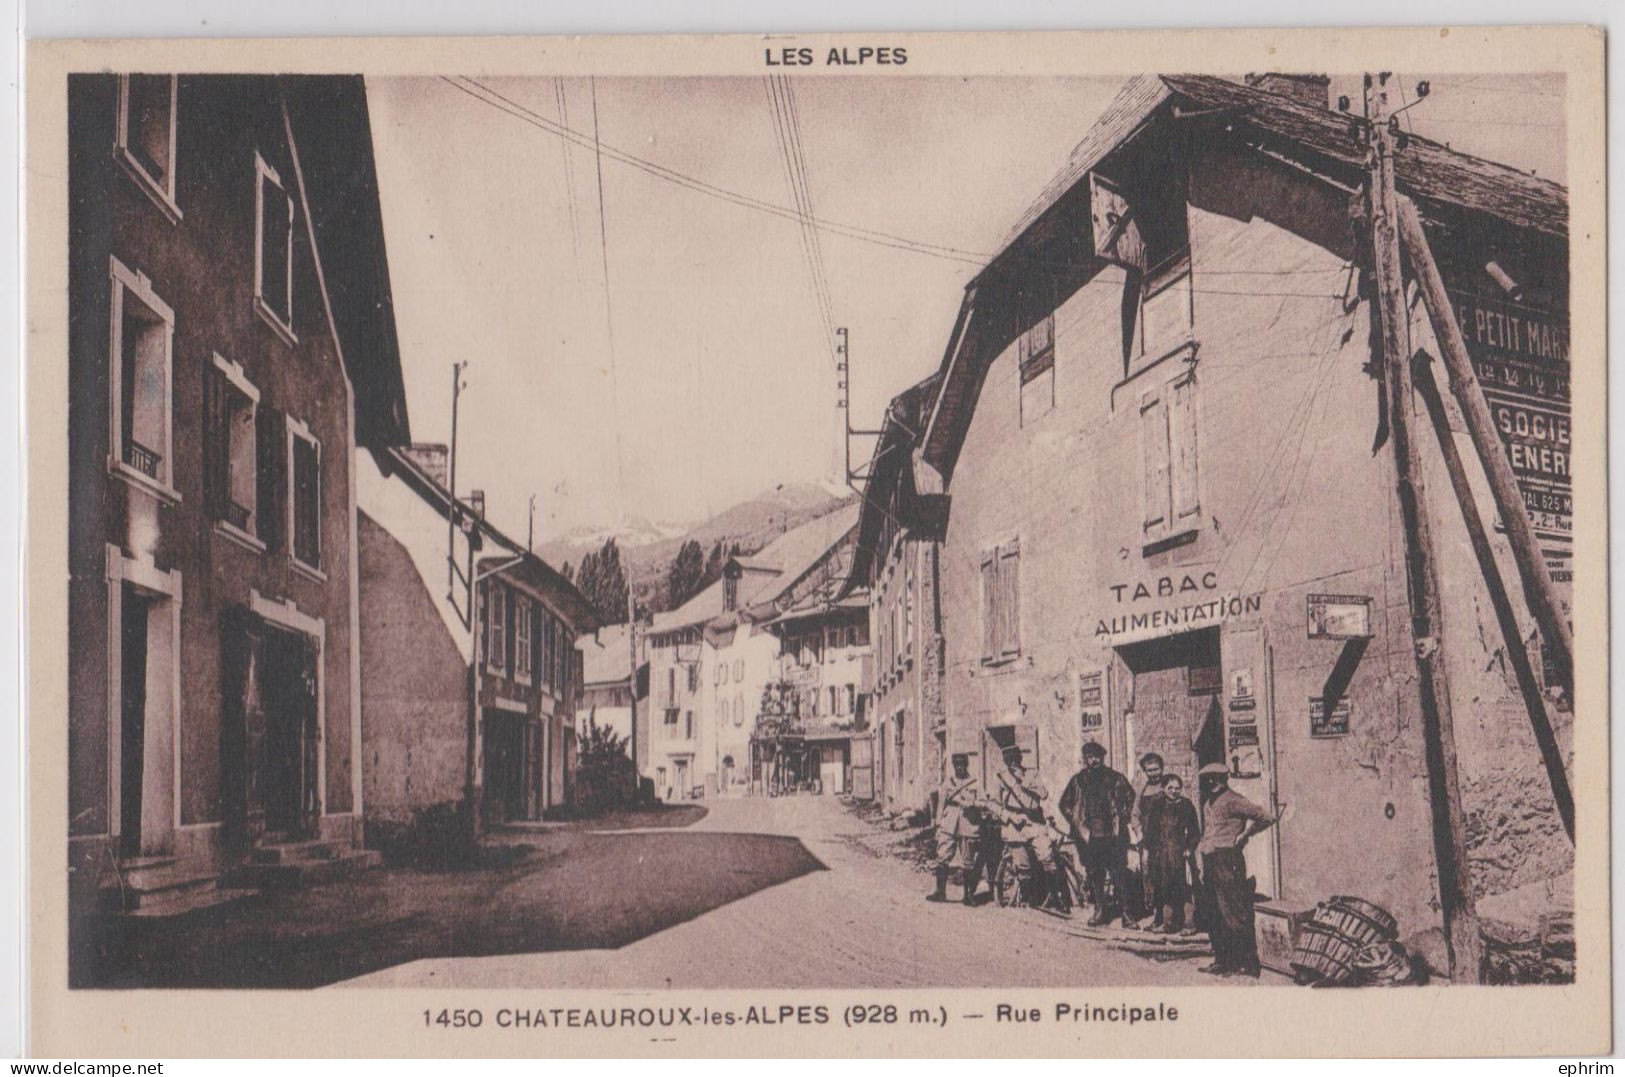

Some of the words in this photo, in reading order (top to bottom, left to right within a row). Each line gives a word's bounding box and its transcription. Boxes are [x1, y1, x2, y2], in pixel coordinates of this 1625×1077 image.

[765, 48, 813, 65] LES
[826, 47, 908, 65] ALPES
[1474, 309, 1520, 352] PETIT
[1110, 571, 1218, 602] TABAC
[1095, 596, 1261, 637] ALIMENTATION
[423, 1009, 483, 1028] 1450
[495, 1005, 829, 1028] CHATEAUROUX-les-ALPES
[844, 1004, 898, 1027] (928
[909, 1005, 948, 1027] m.)
[996, 1004, 1041, 1022] Rue
[1055, 1002, 1179, 1023] Principale
